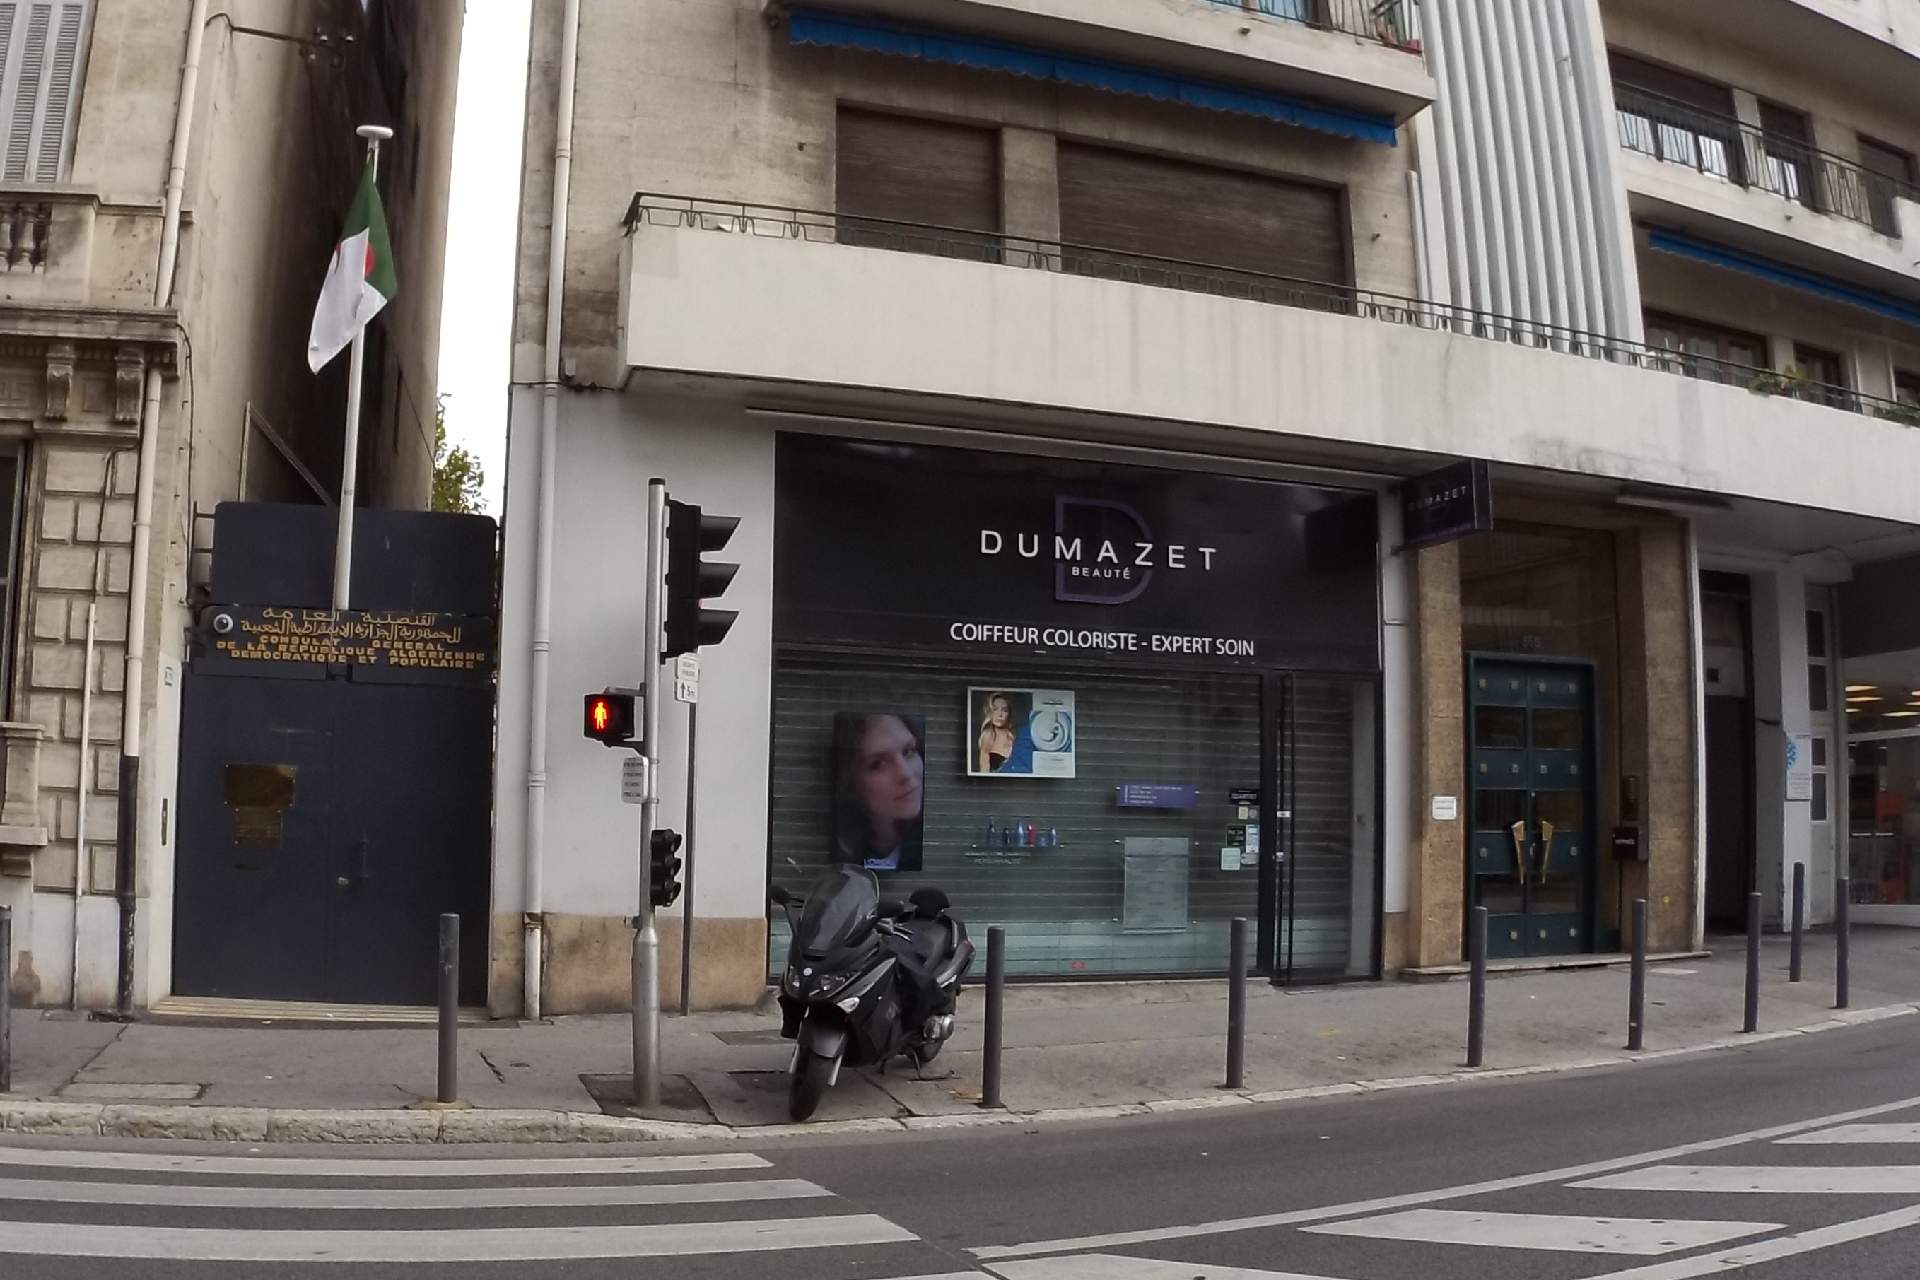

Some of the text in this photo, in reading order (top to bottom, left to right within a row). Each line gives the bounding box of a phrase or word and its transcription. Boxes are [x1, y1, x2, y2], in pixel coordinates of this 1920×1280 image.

[1408, 486, 1467, 511] MAZET
[980, 529, 1217, 571] DUMAZET
[1071, 566, 1131, 580] BEAUTÉ
[259, 635, 445, 651] CONSULAT GENERAL
[950, 622, 1039, 645] COIFFEUR
[1042, 628, 1138, 651] COLORISTE
[1152, 635, 1213, 655] EXPERT
[1216, 637, 1255, 657] SOIN
[216, 641, 486, 661] DE LA REPUBLIQUE ALGERIENNE
[231, 650, 475, 669] DEMOCRATIQUE ET POPULAIRE
